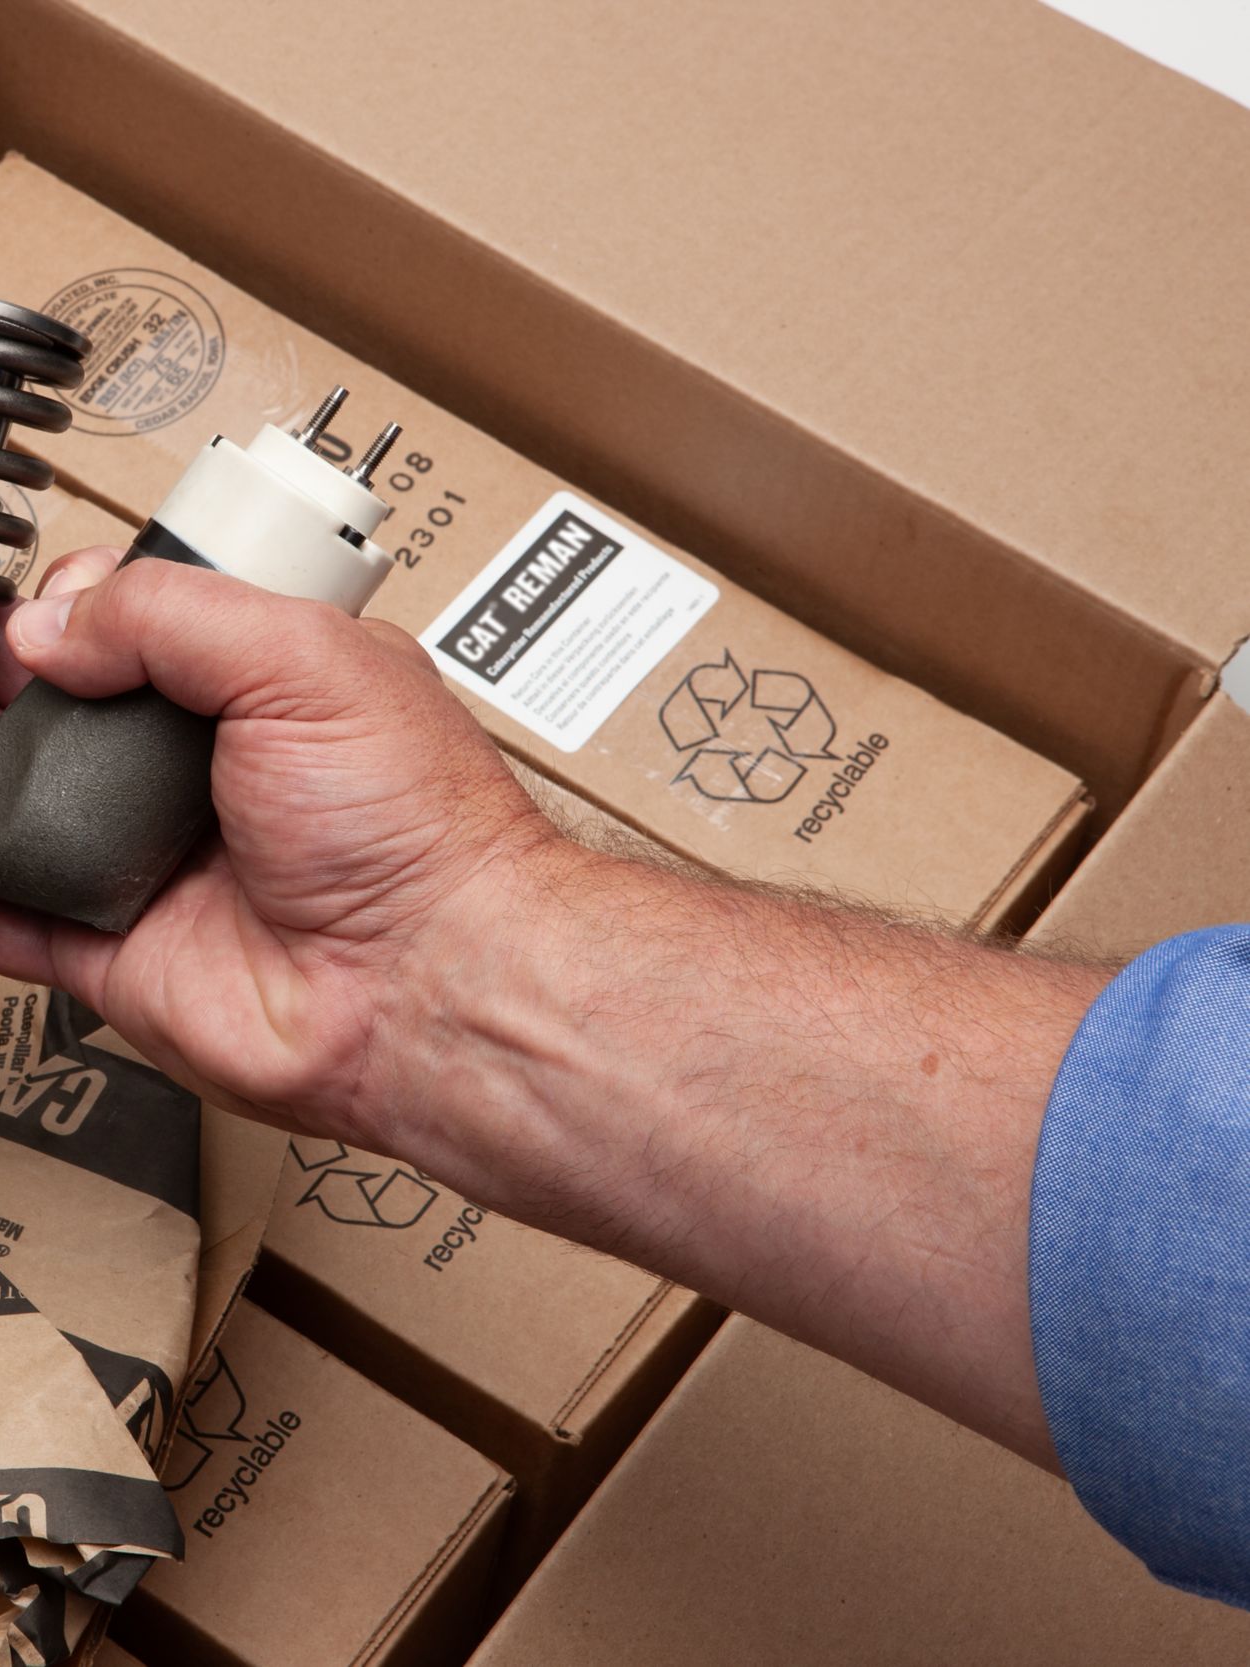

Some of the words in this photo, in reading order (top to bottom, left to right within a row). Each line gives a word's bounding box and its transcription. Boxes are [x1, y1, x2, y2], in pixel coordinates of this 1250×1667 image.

[142, 313, 166, 333] 32
[394, 490, 465, 568] 2301
[503, 522, 590, 610] REMAN
[485, 635, 527, 676] Caterpillar
[522, 575, 583, 637] Remanufactured
[577, 545, 613, 579] Products
[794, 729, 890, 844] recyclable
[10, 993, 37, 1073] Caterpillar
[423, 1199, 488, 1272] recycl
[192, 1409, 302, 1539] recyclable
